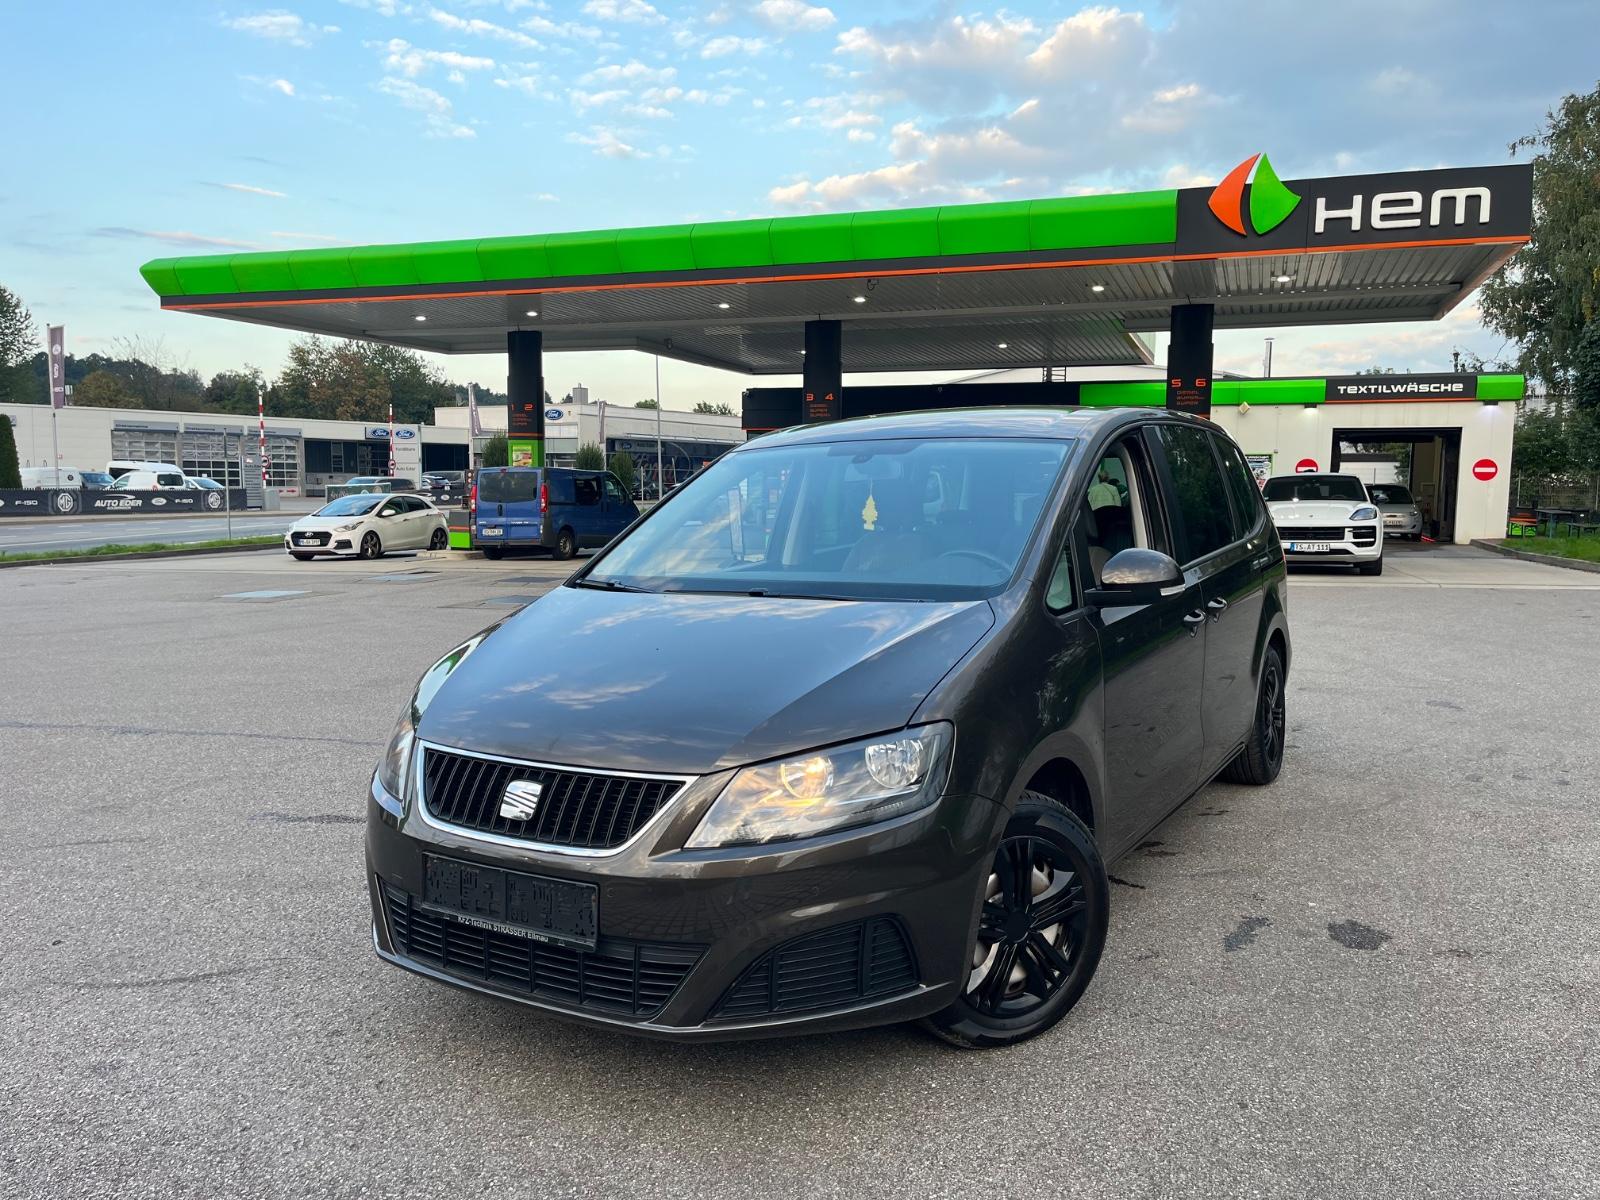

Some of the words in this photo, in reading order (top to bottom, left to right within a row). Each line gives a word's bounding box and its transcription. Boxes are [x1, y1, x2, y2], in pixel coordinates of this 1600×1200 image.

[1171, 379, 1181, 387] 5
[1195, 379, 1206, 387] 6
[806, 393, 814, 401] 3
[825, 393, 834, 401] 4
[524, 403, 533, 411] 2
[59, 495, 72, 510] MG
[94, 499, 118, 507] AUTO
[119, 499, 142, 507] EDER
[1316, 543, 1329, 551] 111
[493, 923, 527, 938] STRASSER
